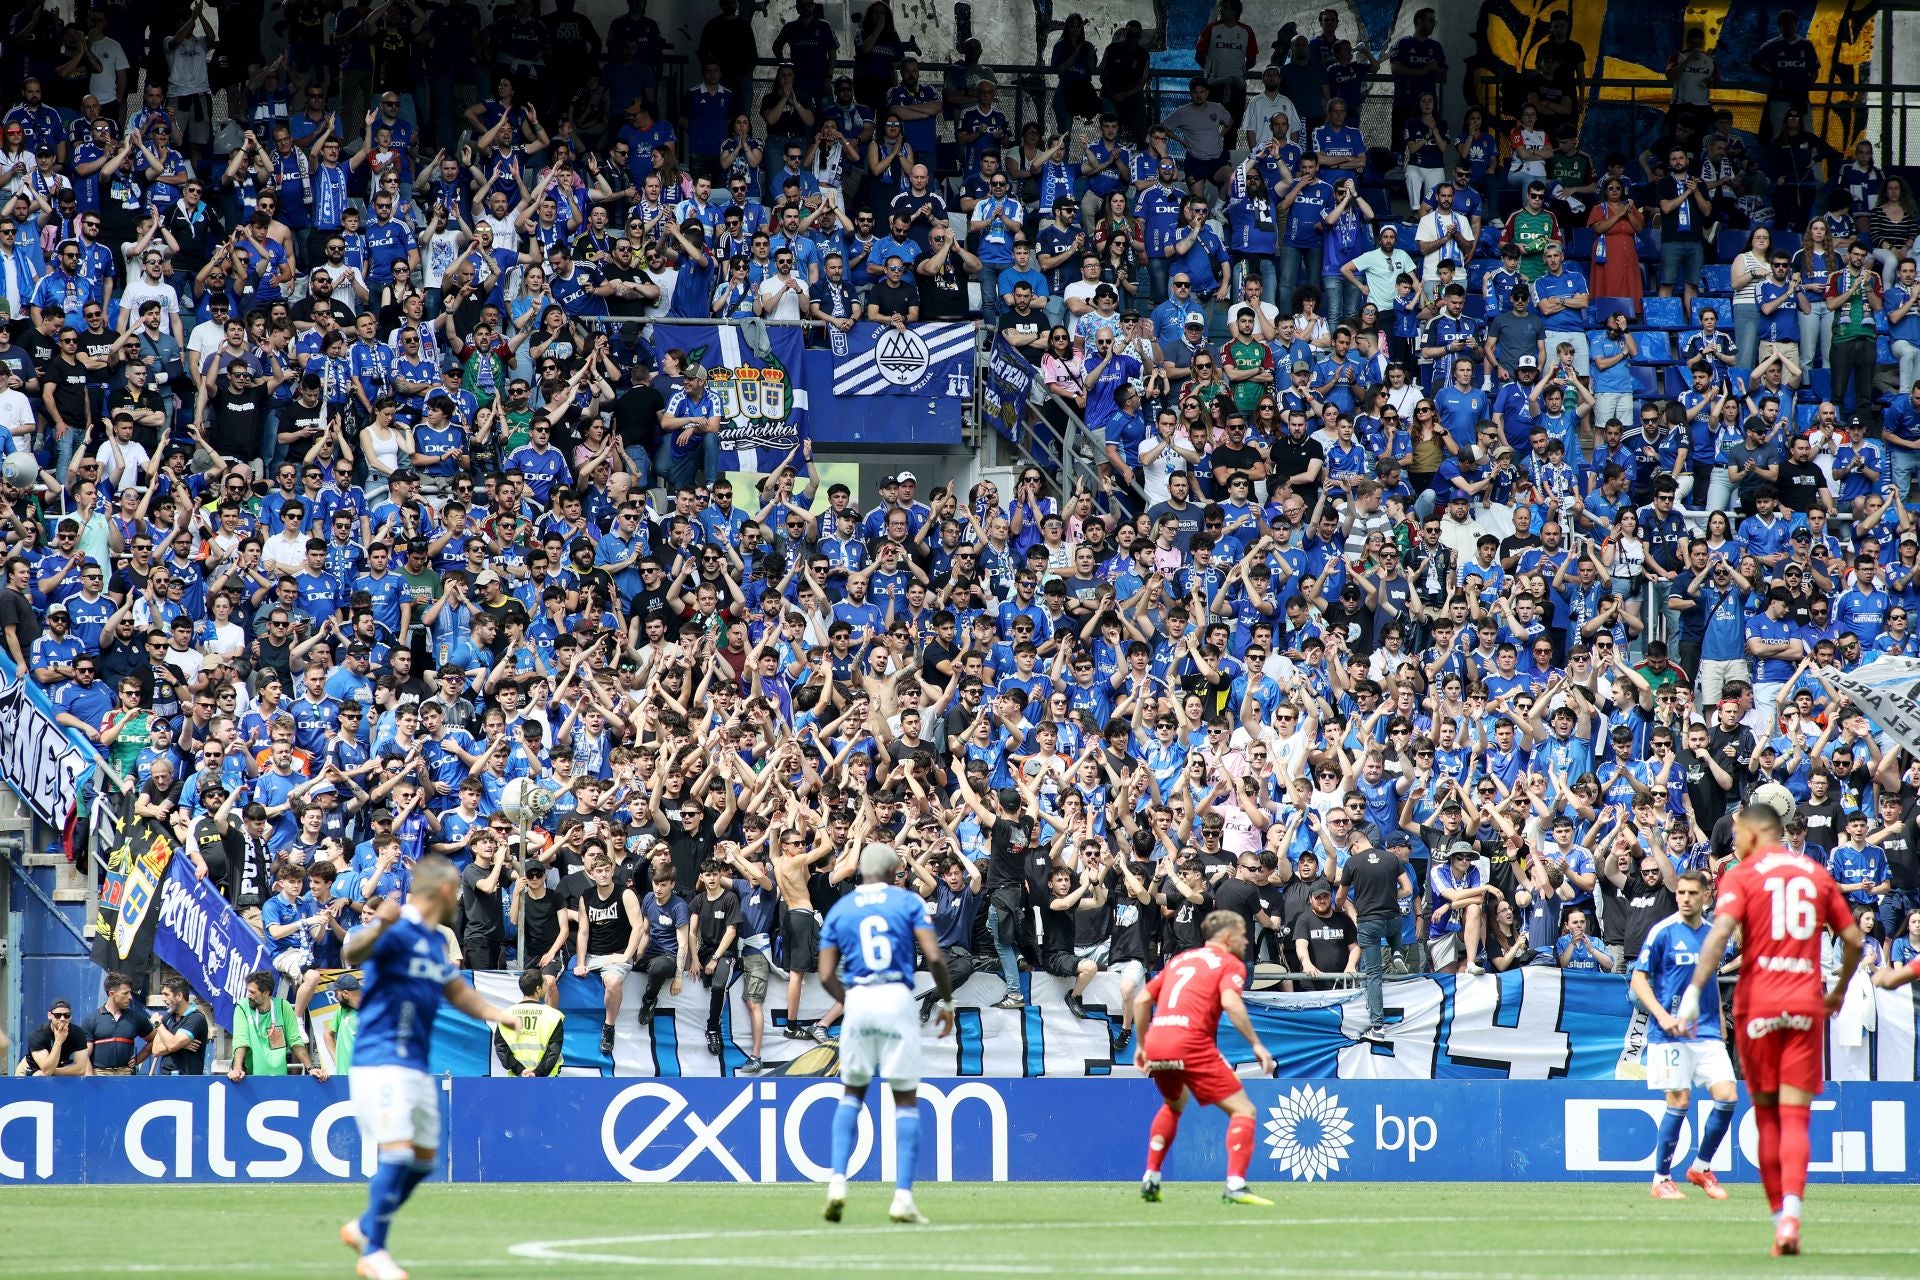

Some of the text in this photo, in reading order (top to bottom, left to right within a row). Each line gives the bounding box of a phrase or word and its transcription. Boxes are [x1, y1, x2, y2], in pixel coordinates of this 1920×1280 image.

[1215, 43, 1242, 51] DIGI
[1682, 66, 1709, 74] DIGI
[1777, 61, 1806, 69] DIGI
[1554, 170, 1582, 180] DIGI
[1295, 197, 1324, 207] DIGI
[368, 237, 394, 249] DIGI
[1236, 358, 1261, 367] DIGI
[909, 371, 934, 393] SPEZIAL
[718, 422, 798, 439] ambolikos
[523, 473, 554, 482] DIGI
[308, 591, 334, 602] DIGI
[76, 615, 108, 625] DIGI
[1844, 869, 1875, 878] DIGI
[588, 902, 619, 923] EVERLAST
[1764, 876, 1817, 941] 16
[859, 915, 892, 971] 6
[1567, 960, 1594, 969] sturias
[1169, 966, 1196, 1008] 7
[1664, 1049, 1680, 1066] 12
[601, 1082, 1009, 1183] exiom
[1376, 1104, 1438, 1163] bp
[1565, 1099, 1906, 1172] DIGI
